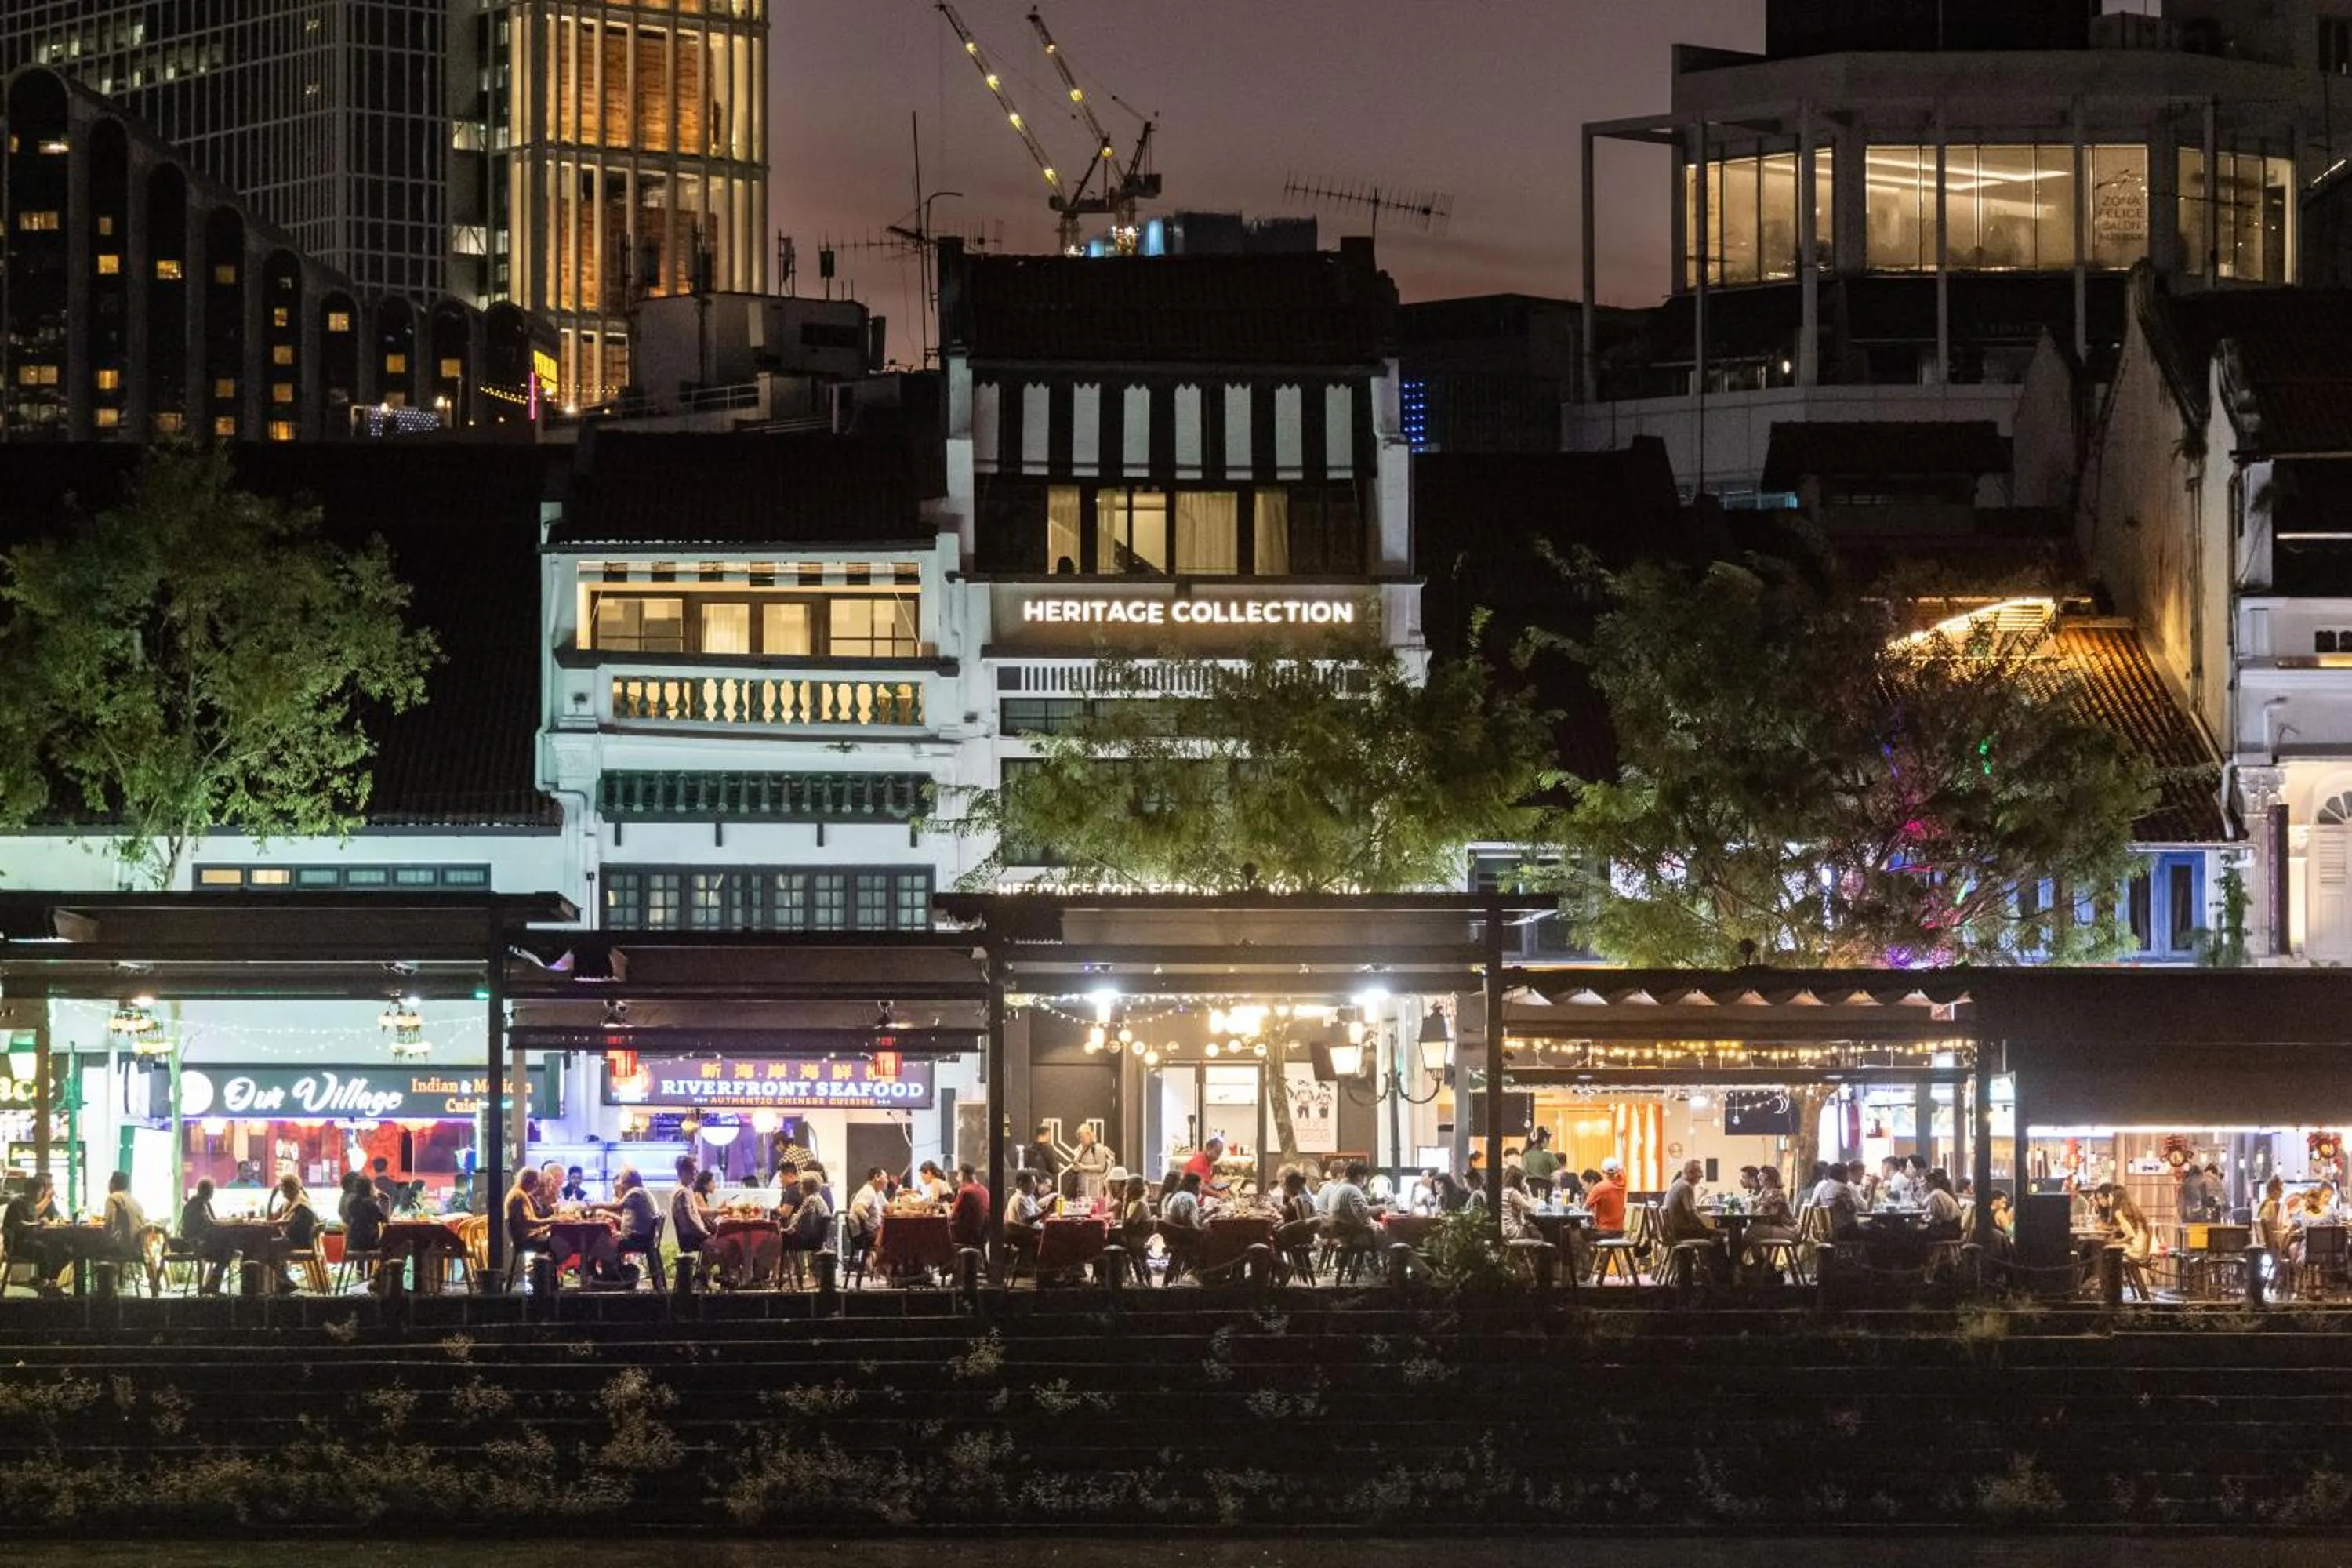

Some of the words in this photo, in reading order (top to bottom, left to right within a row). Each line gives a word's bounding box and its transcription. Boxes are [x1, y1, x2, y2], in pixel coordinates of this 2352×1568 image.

[1024, 601, 1164, 624] HERITAGE
[1171, 601, 1353, 624] COLLECTION
[223, 1077, 285, 1112] Our
[291, 1071, 404, 1116] Village
[411, 1077, 459, 1094] Indian
[661, 1079, 811, 1097] RIVERFRONT
[815, 1081, 924, 1098] SEAFOOD
[777, 1097, 825, 1105] CHINESE
[829, 1097, 876, 1105] CUISINE
